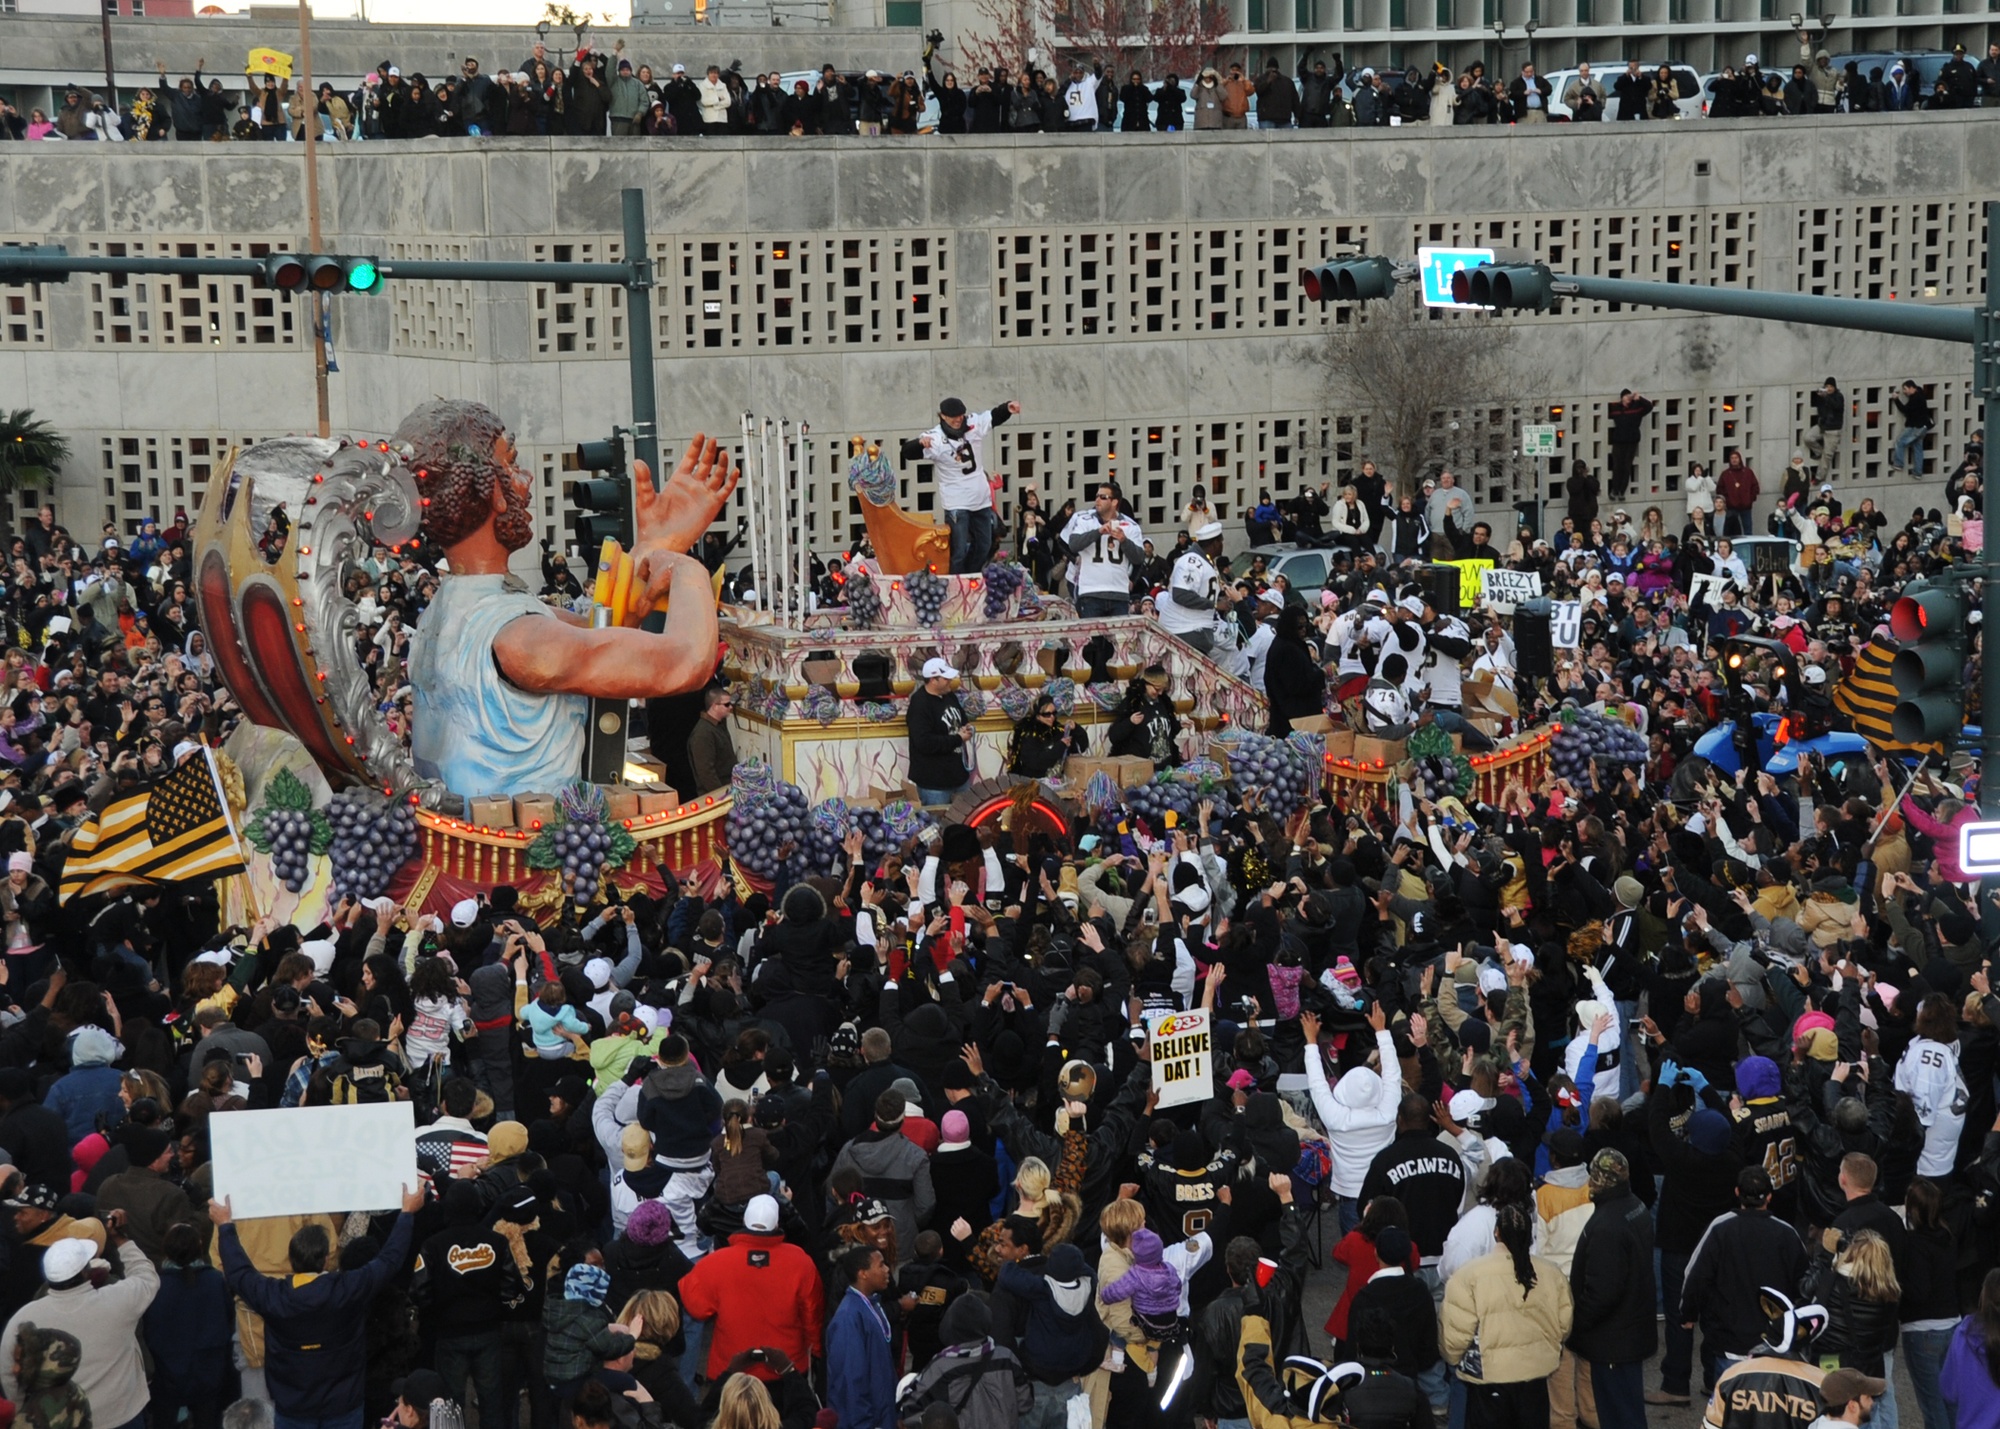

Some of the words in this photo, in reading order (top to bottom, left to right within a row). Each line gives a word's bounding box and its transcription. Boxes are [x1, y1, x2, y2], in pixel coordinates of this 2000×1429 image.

[1487, 571, 1534, 588] BREEZY
[408, 1011, 447, 1040] 25
[1153, 1033, 1209, 1061] BELIEVE
[1920, 1050, 1944, 1069] 55
[1164, 1059, 1191, 1082] DAT
[1762, 1136, 1797, 1190] 42
[1176, 1183, 1215, 1201] BREES
[1732, 1389, 1816, 1422] SAINTS
